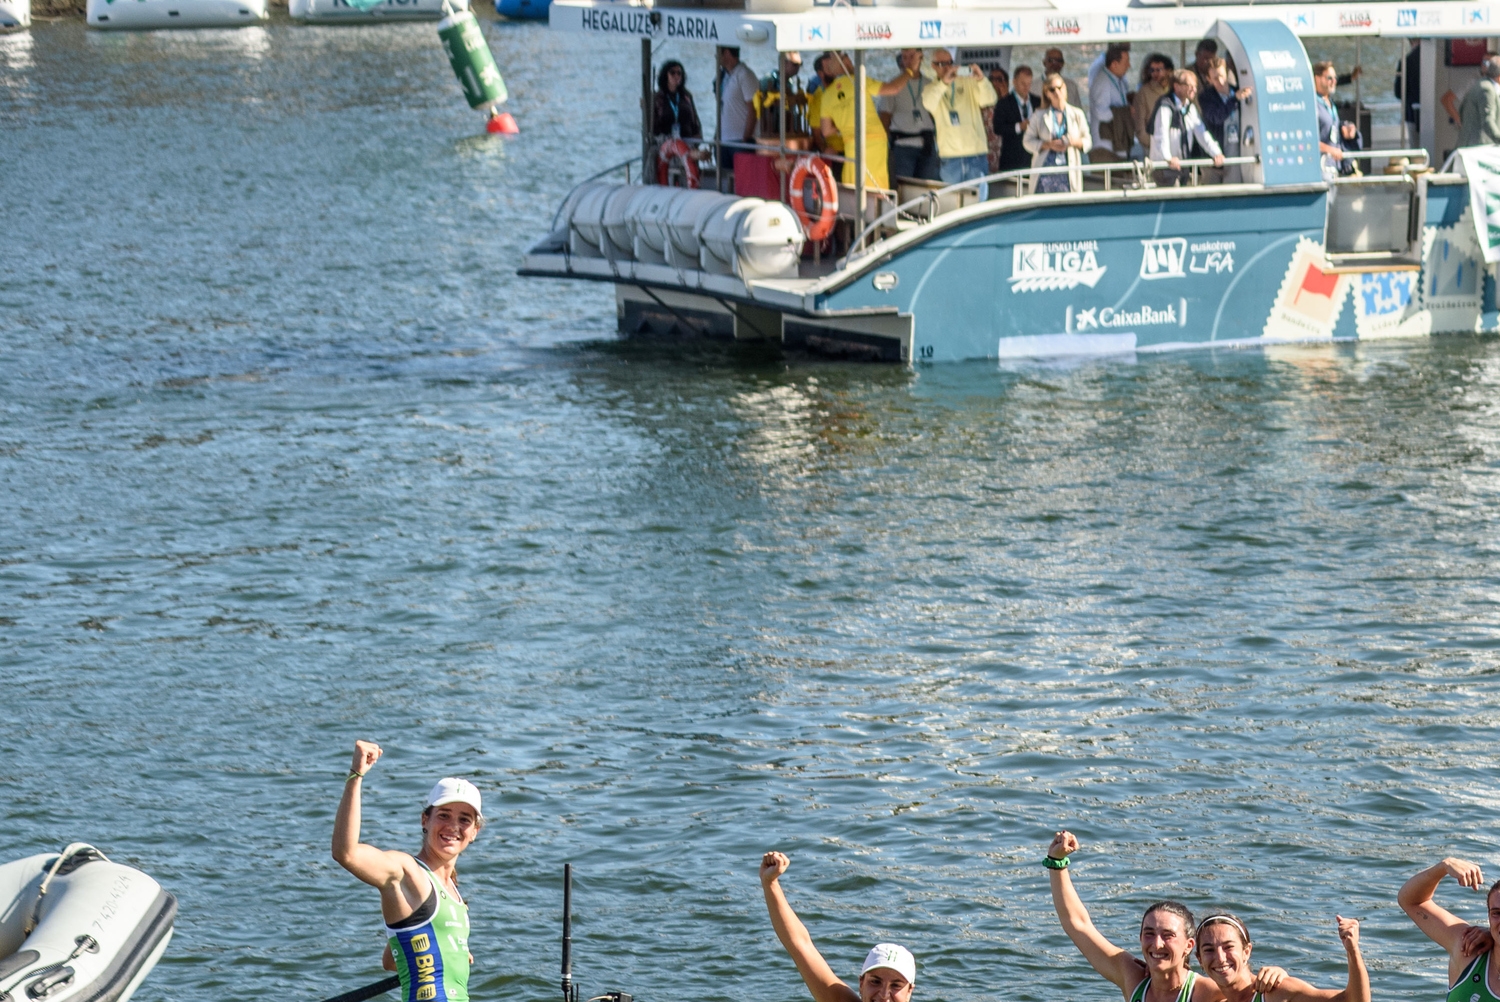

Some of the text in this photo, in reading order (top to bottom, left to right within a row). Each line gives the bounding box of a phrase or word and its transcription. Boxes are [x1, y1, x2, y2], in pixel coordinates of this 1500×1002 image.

[667, 14, 719, 41] BARRIA
[1073, 240, 1099, 252] LABEL
[1190, 241, 1236, 252] euskotren
[1043, 250, 1099, 273] LIGA
[1100, 303, 1177, 328] CaixaBank
[415, 953, 436, 984] BM
